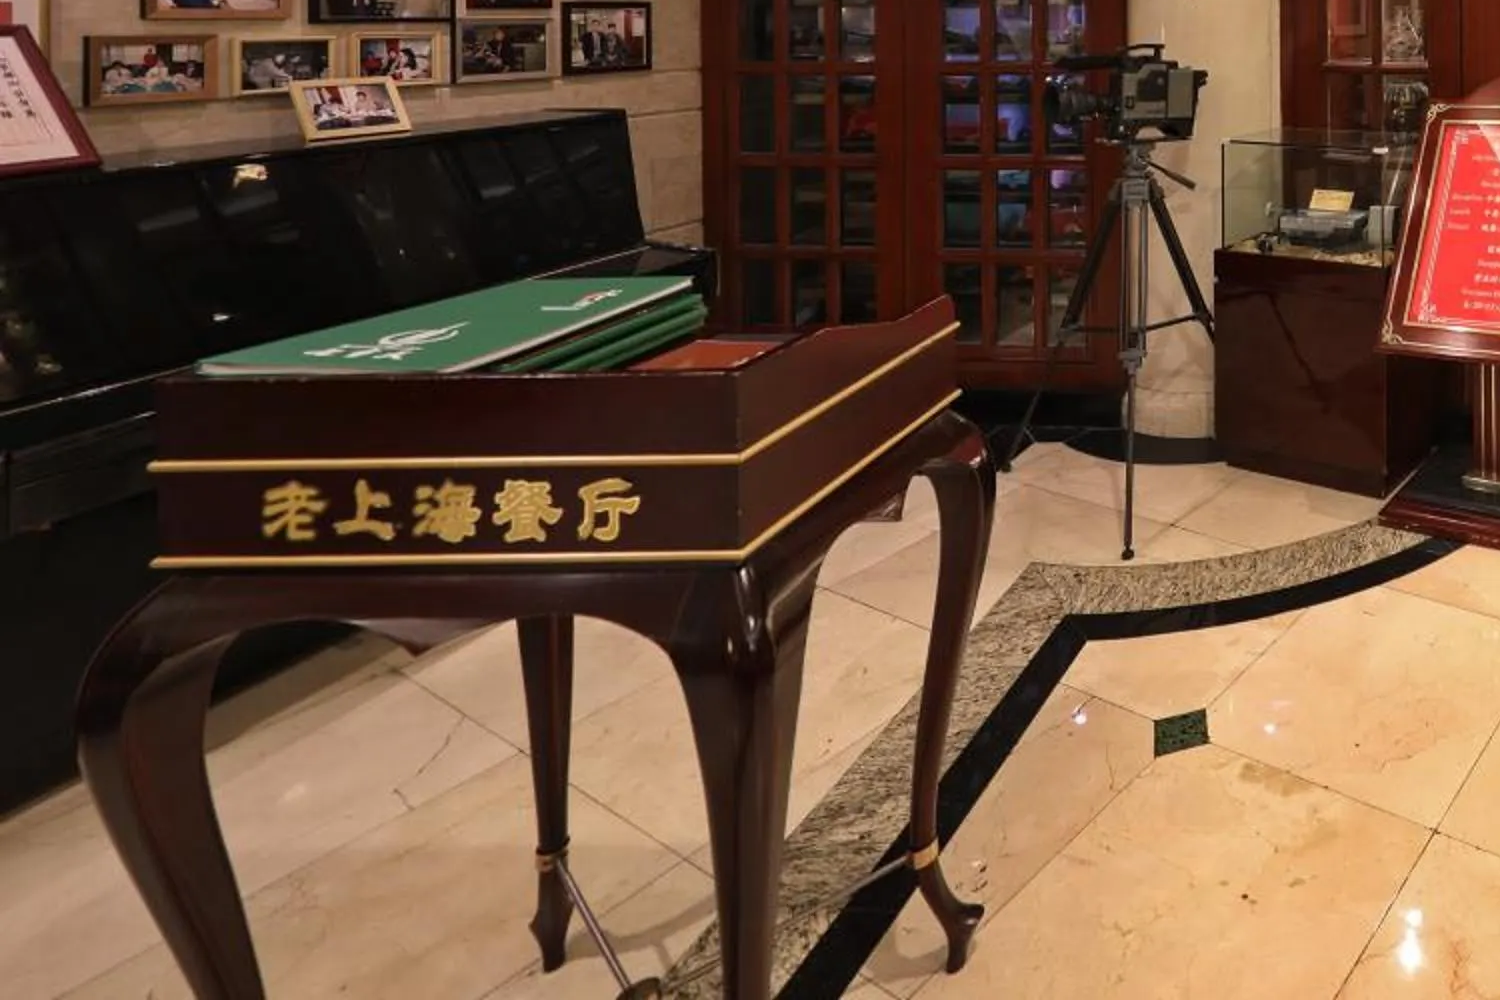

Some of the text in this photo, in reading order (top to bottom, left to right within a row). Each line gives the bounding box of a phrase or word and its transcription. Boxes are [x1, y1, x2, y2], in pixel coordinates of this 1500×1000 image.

[261, 478, 641, 544] 老上海餐厅
